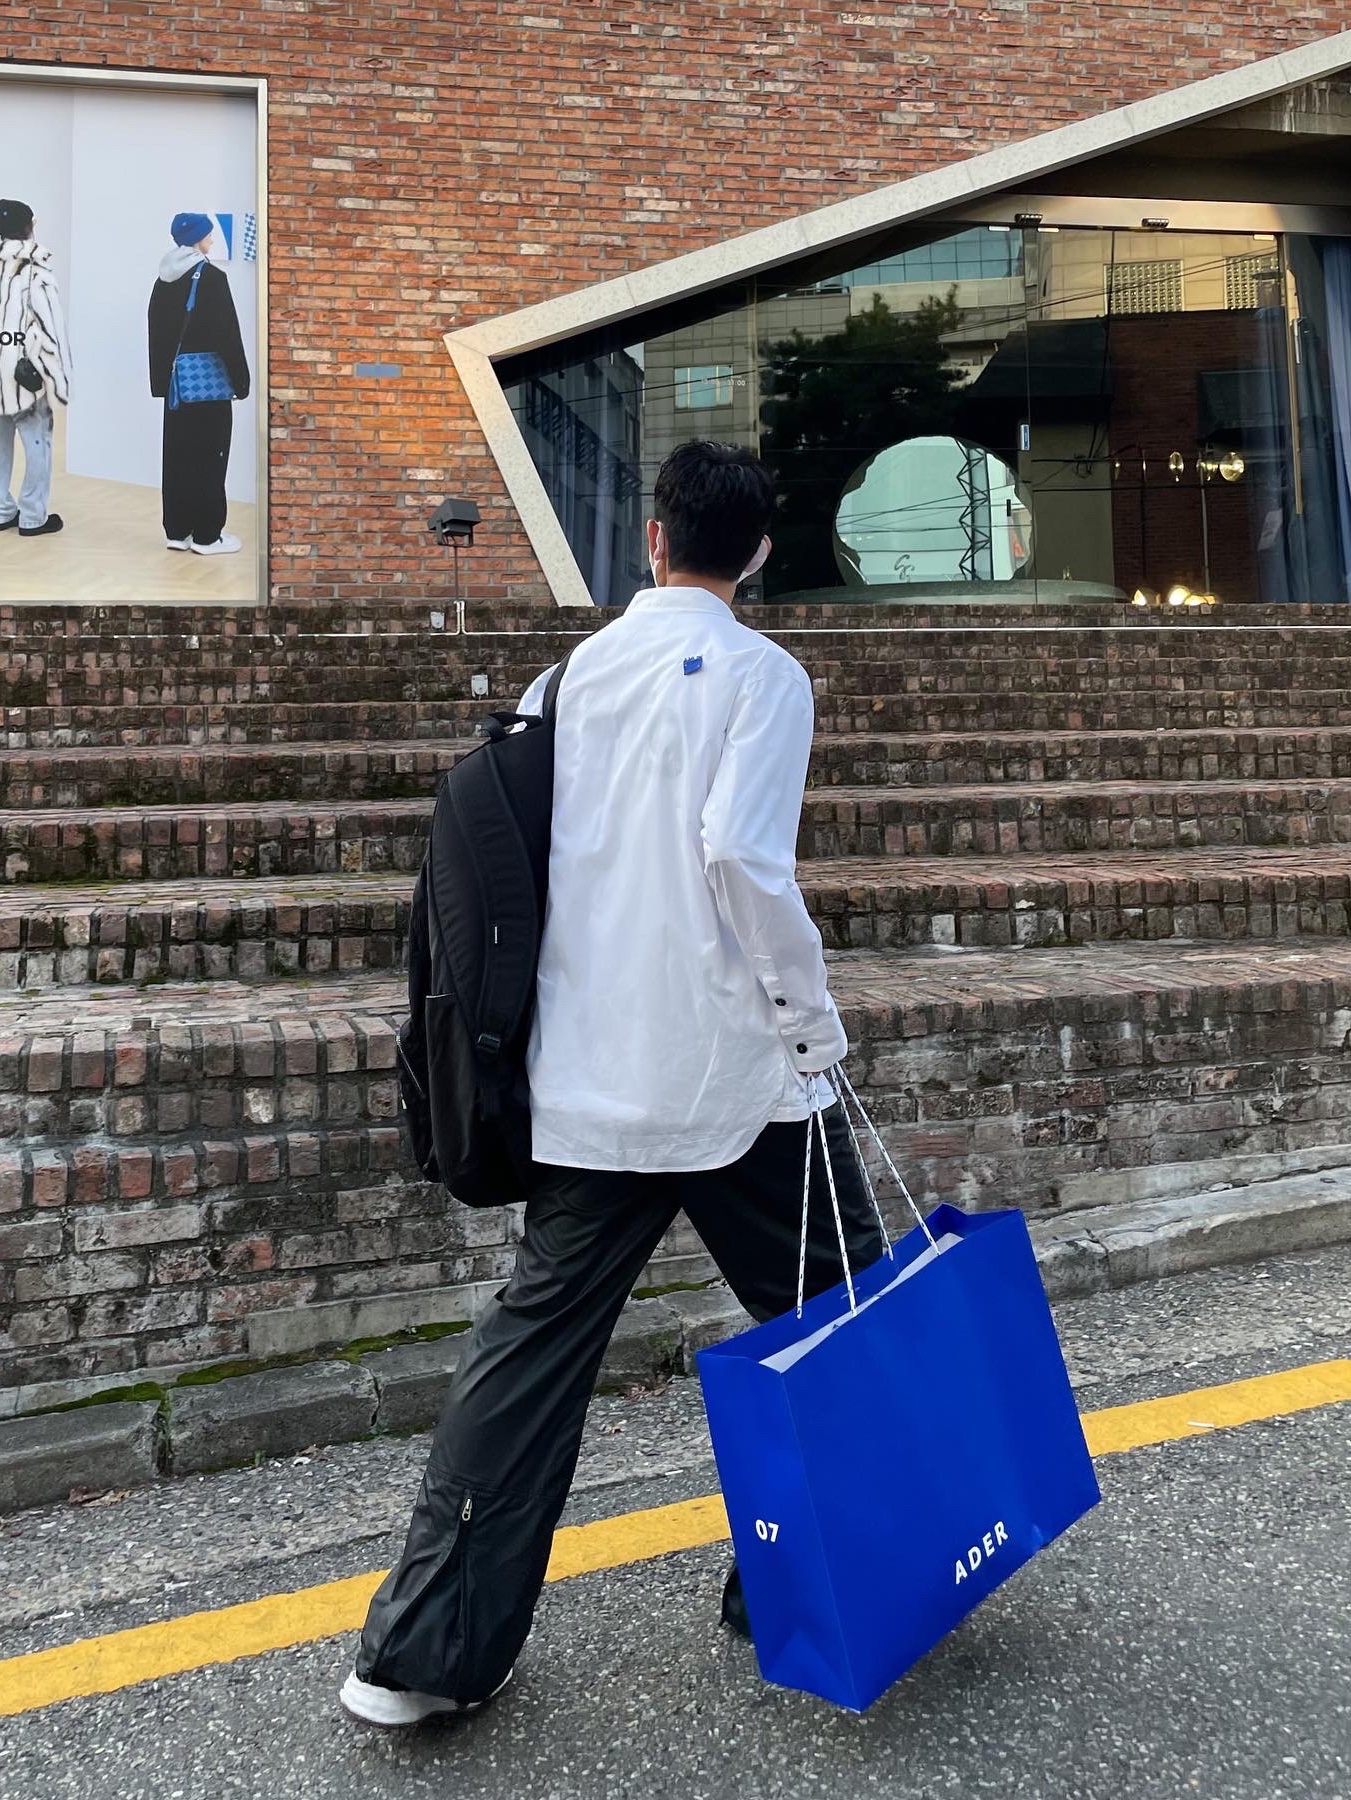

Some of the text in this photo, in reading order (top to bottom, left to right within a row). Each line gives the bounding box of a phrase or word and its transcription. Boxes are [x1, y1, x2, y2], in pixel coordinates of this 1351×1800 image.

[0, 331, 26, 346] OR
[755, 1519, 779, 1543] 07
[955, 1521, 1008, 1585] ADER
